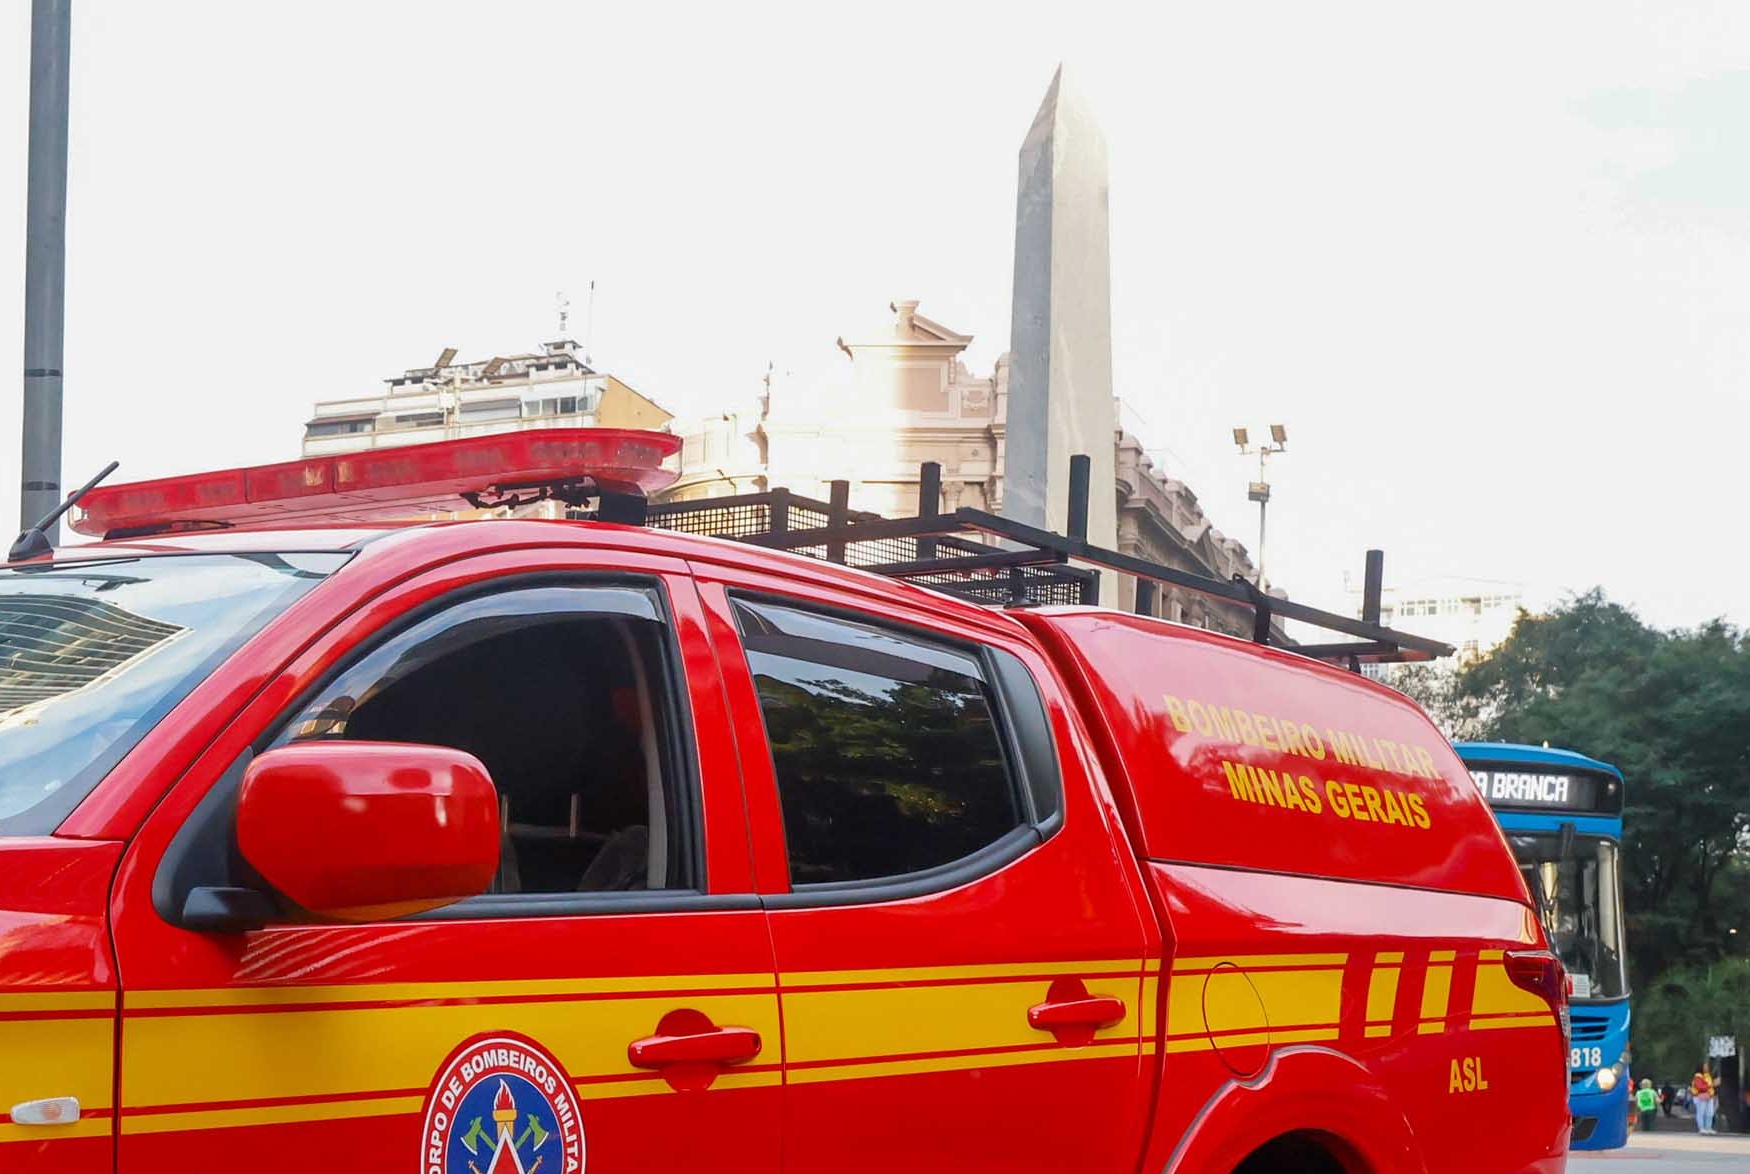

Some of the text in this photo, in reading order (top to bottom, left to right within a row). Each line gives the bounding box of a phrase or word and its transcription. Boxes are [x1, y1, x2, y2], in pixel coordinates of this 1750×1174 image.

[1164, 695, 1442, 779] BOMBEIRO MILITAR
[1222, 761, 1431, 829] MINAS GERAIS
[1492, 773, 1569, 802] BRANCA
[441, 1078, 464, 1111] DE
[460, 1049, 557, 1095] BOMBEIROS
[1449, 1057, 1488, 1093] ASL
[1571, 1047, 1601, 1068] 818
